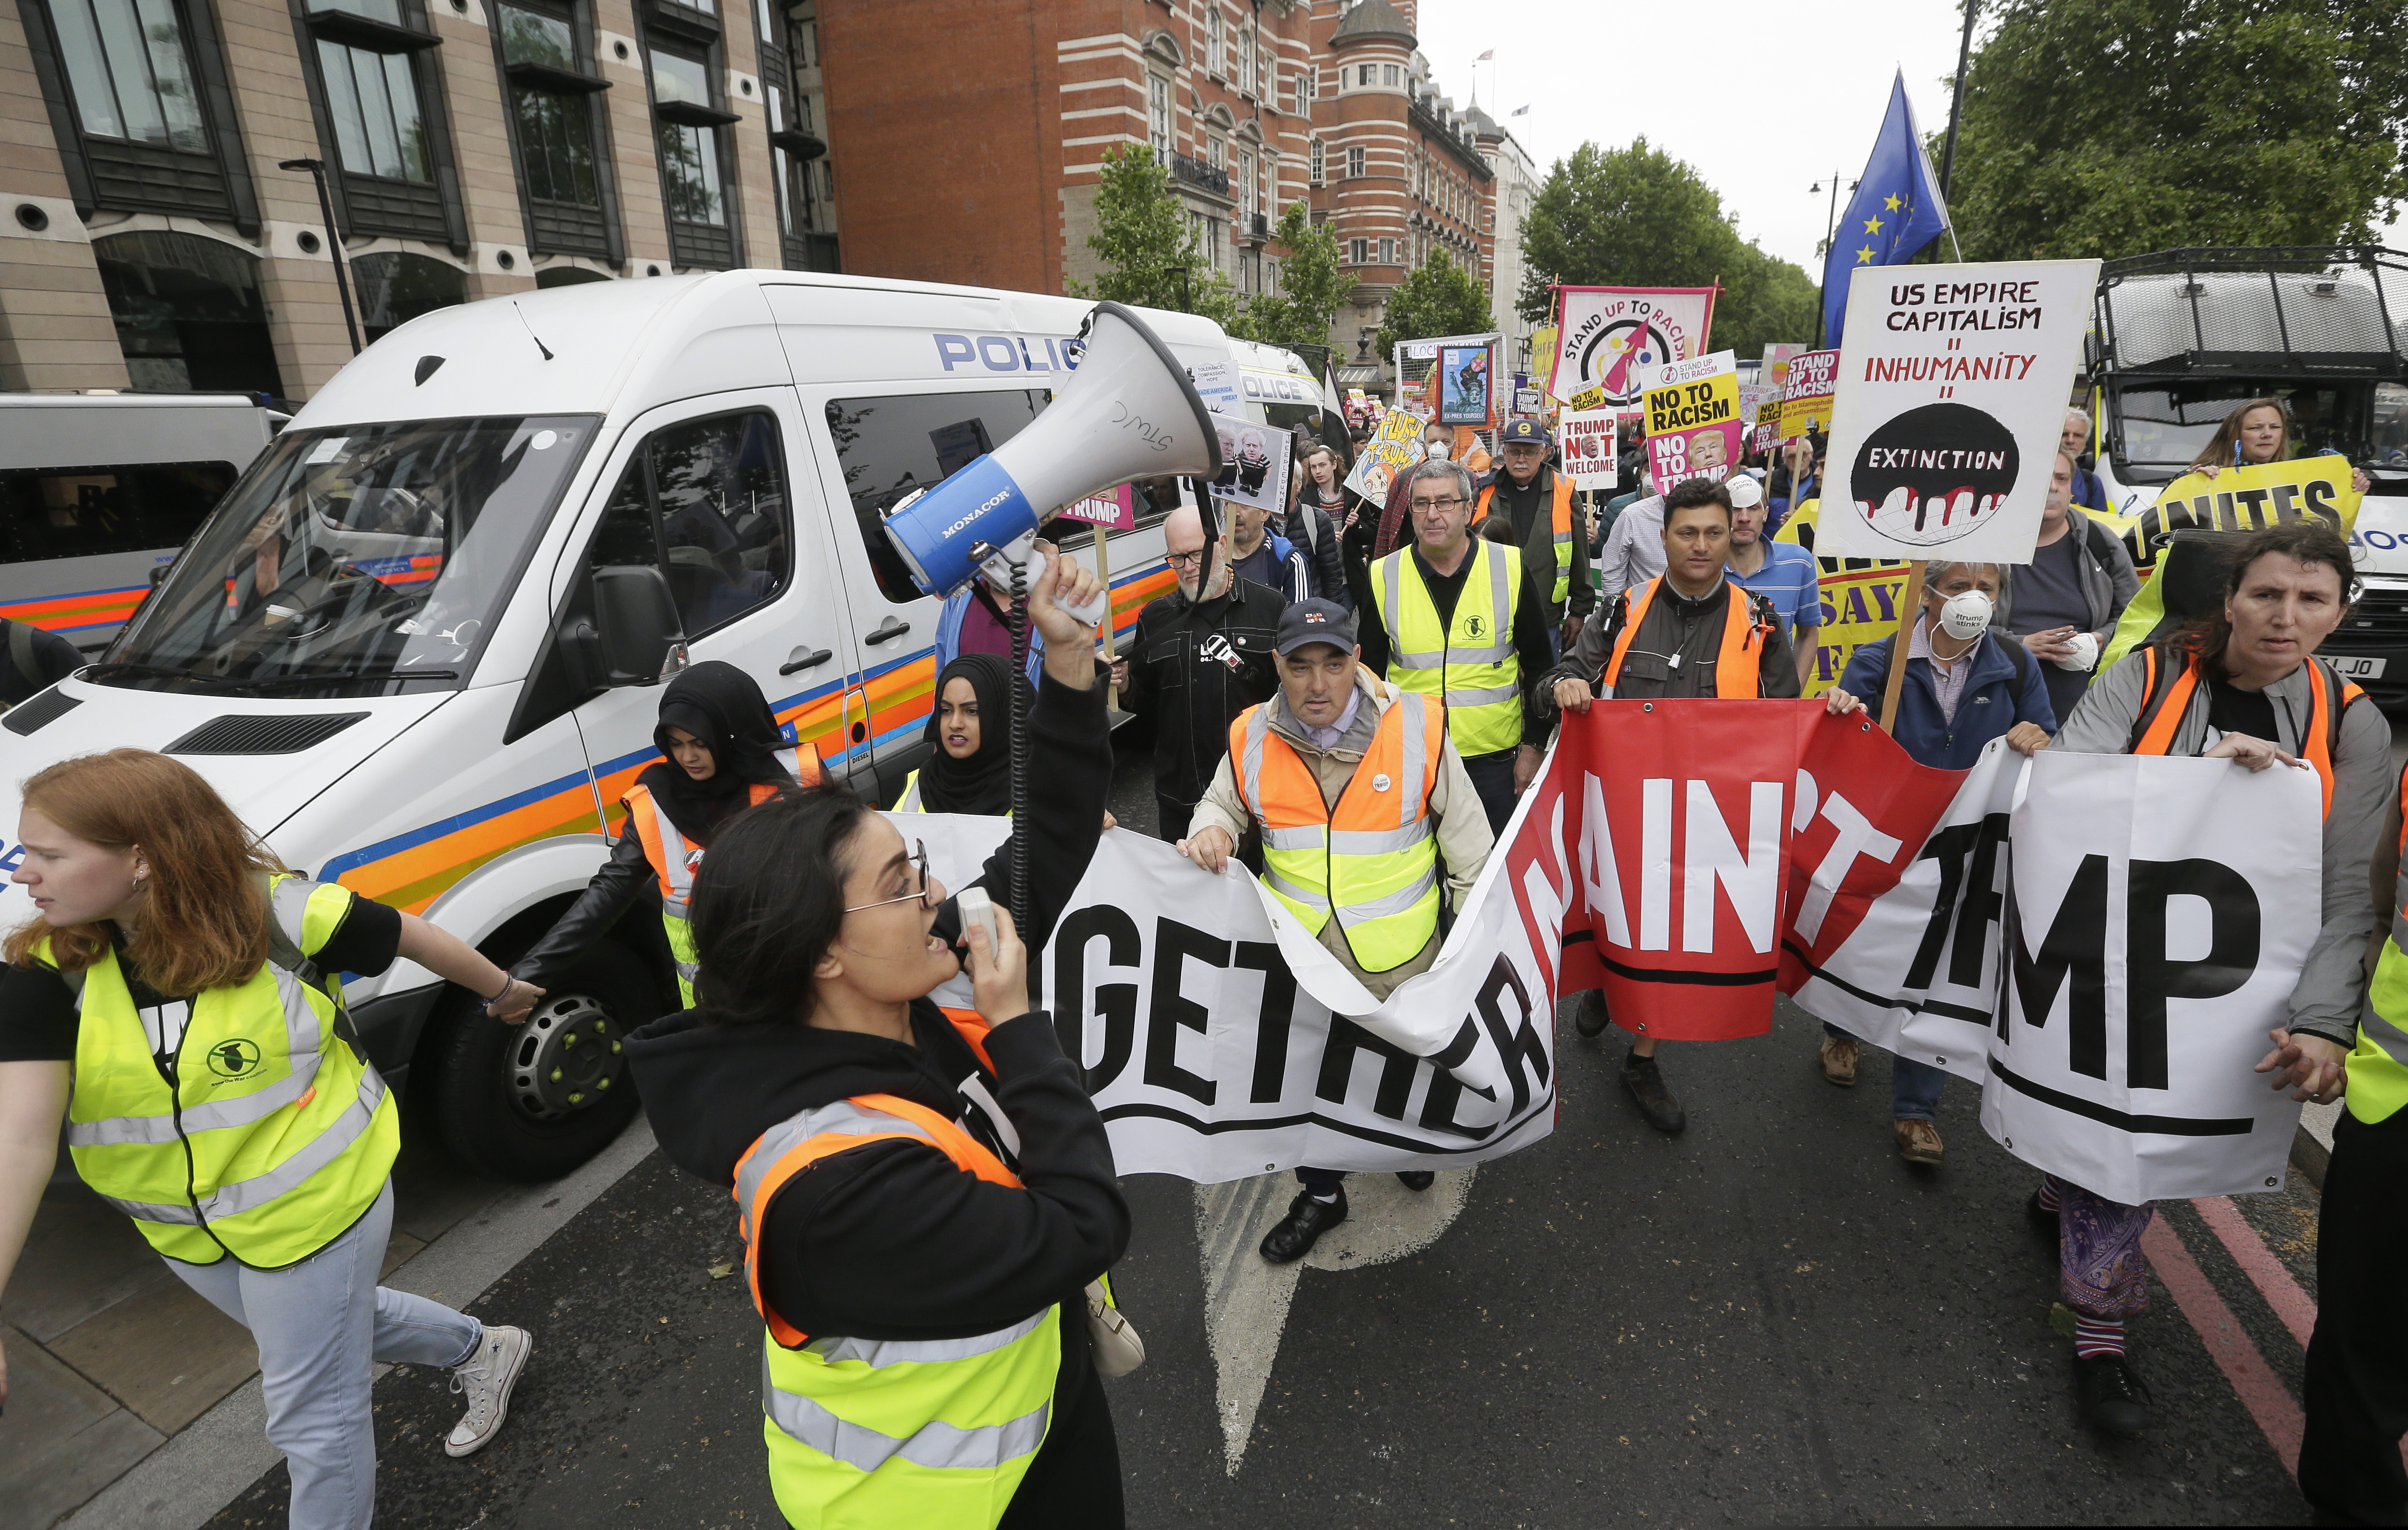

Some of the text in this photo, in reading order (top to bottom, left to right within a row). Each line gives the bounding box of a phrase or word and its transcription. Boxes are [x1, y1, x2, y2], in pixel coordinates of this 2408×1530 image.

[1891, 281, 2040, 306] US EMPIRE
[1565, 314, 1601, 359] STAND
[1605, 301, 1625, 317] UP
[1631, 300, 1651, 314] TO
[933, 334, 1086, 371] POLIC
[1679, 361, 1701, 372] STAND
[1789, 354, 1835, 373] STAND
[1680, 367, 1717, 380] TO RACISM
[1788, 368, 1829, 386] UP TO
[1572, 390, 1593, 405] NO TO
[1651, 383, 1713, 412] NO TO
[1785, 379, 1836, 400] RACISM
[1517, 393, 1538, 404] DUMP
[1573, 396, 1600, 411] RACISM
[1652, 398, 1729, 431] RACISM
[1761, 404, 1774, 414] NO
[1793, 407, 1829, 416] antisemitism
[1378, 410, 1423, 451] FLUSH
[1565, 419, 1614, 435] TRUMP
[1757, 424, 1771, 435] NO
[1655, 435, 1686, 458] NO
[1757, 434, 1770, 443] TO
[1566, 459, 1615, 475] WELCOME
[1657, 454, 1686, 476] TO
[1869, 448, 2007, 470] EXTINCTION
[942, 491, 1010, 538] MONACOR
[1818, 582, 1903, 627] SAY
[1955, 613, 1983, 622] #trump
[852, 752, 869, 764] DIESEL
[246, 1068, 268, 1079] coalition
